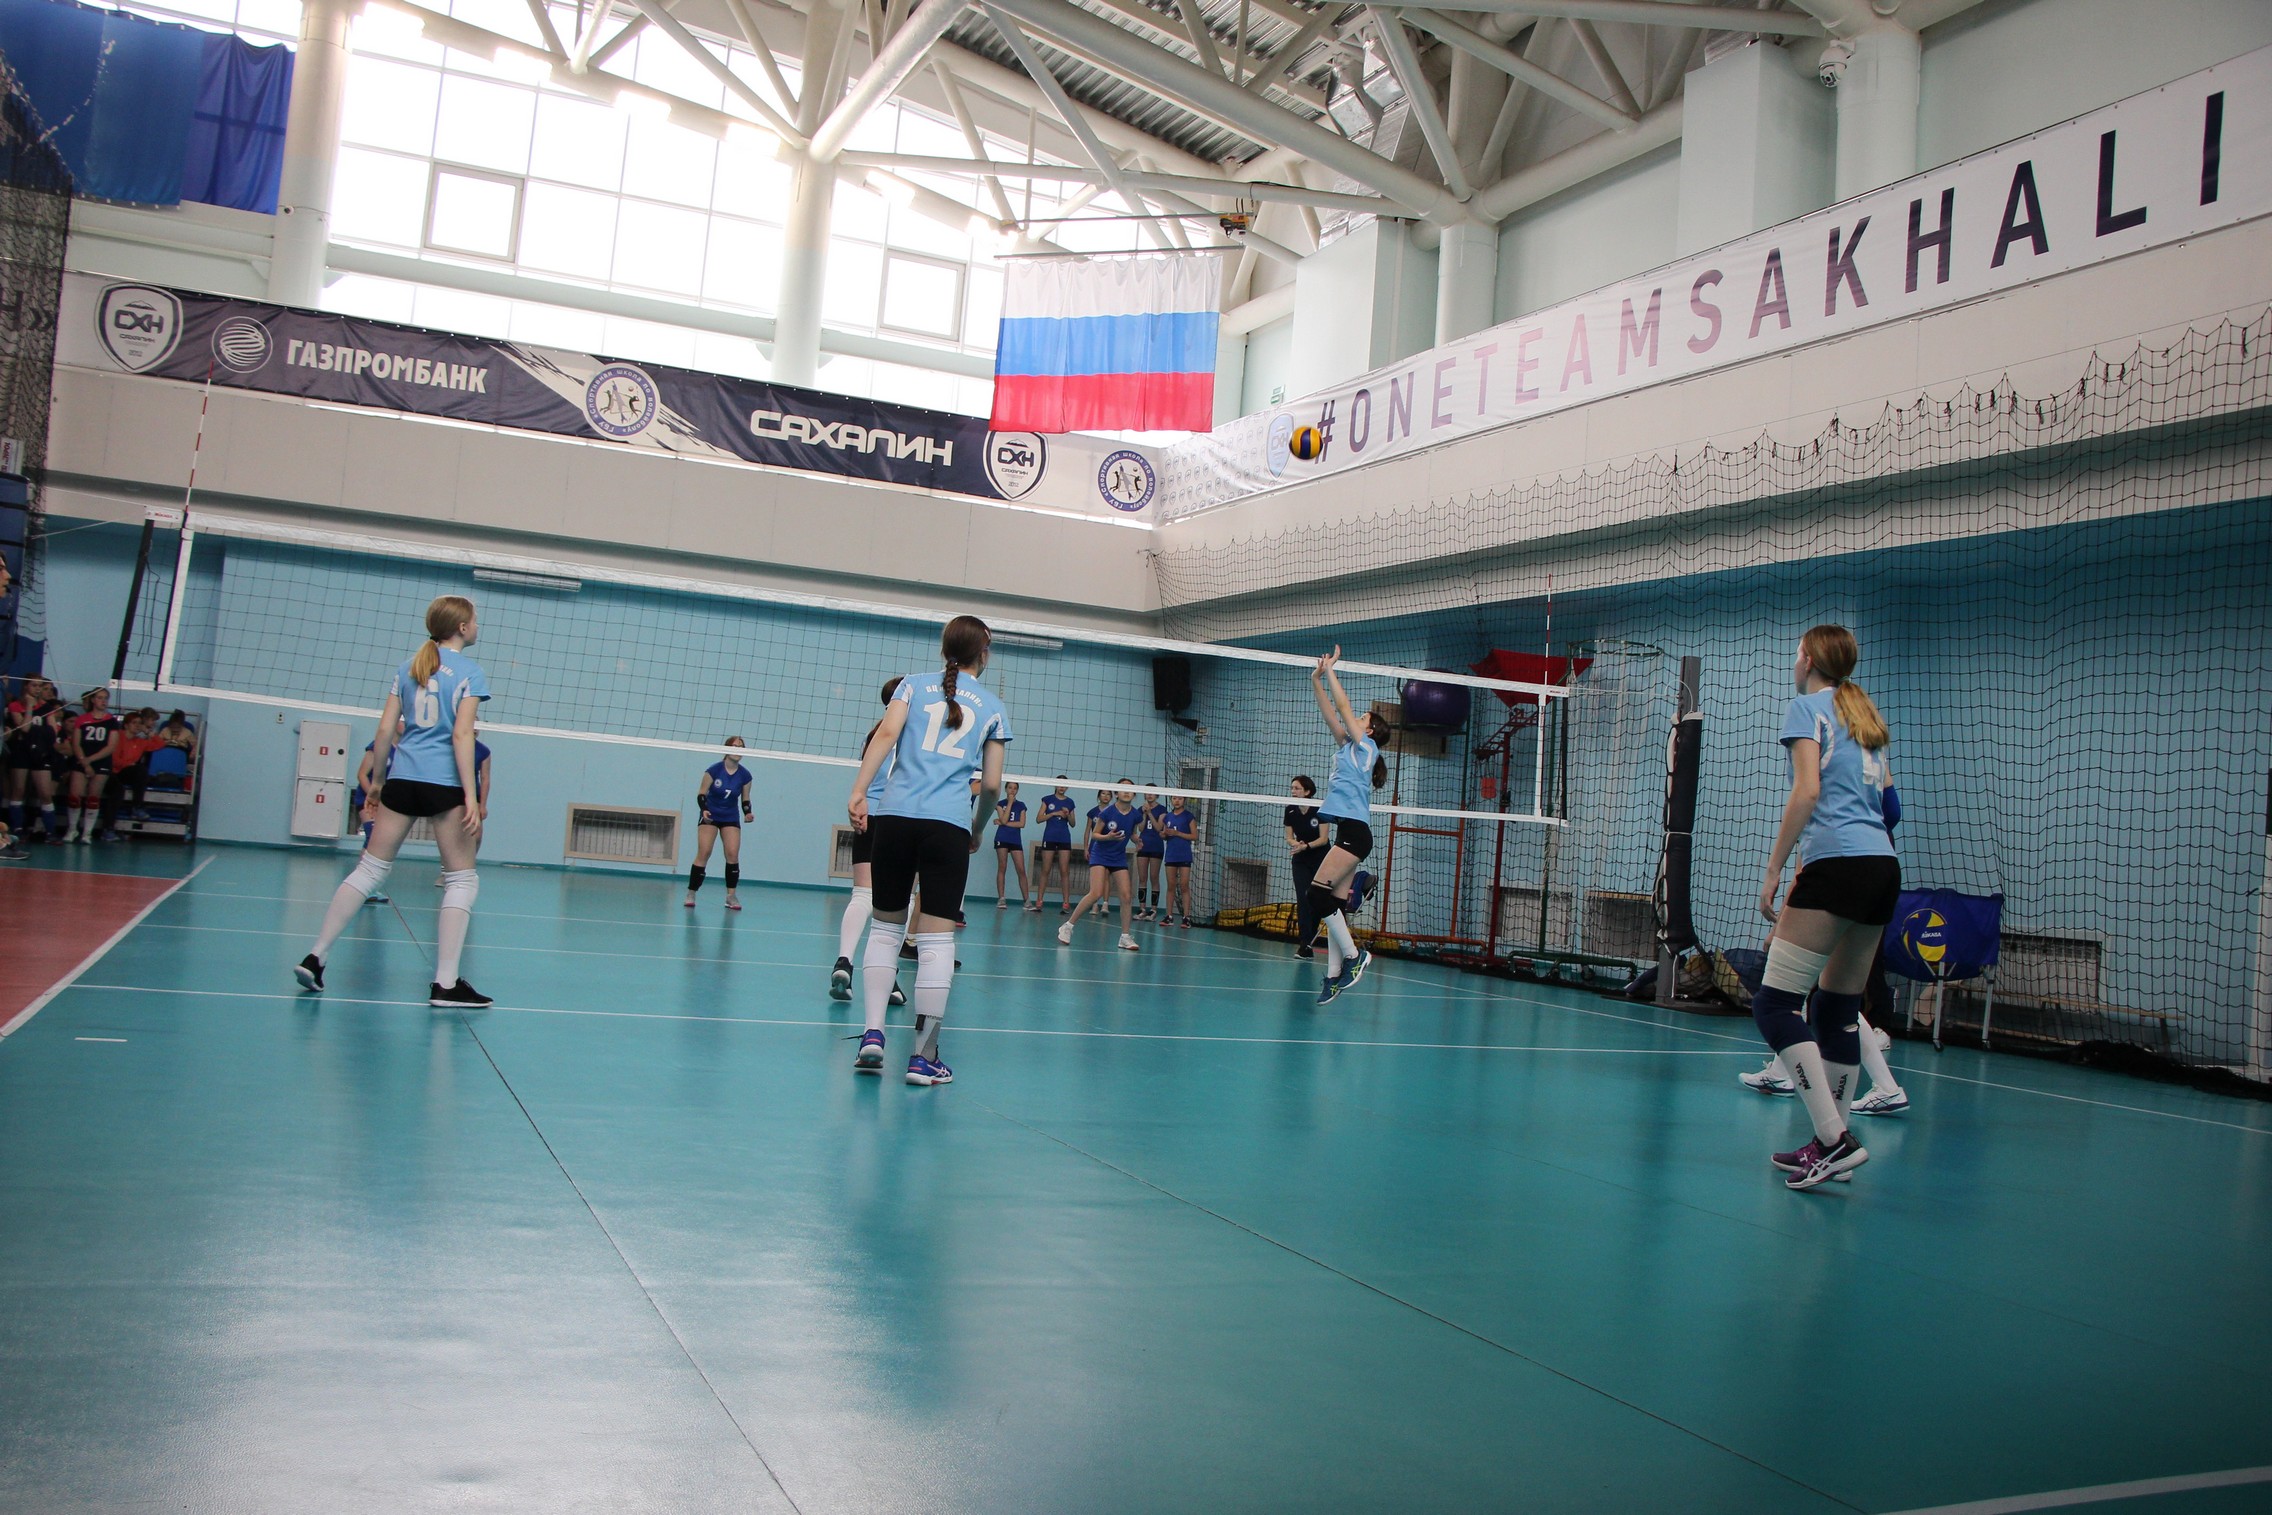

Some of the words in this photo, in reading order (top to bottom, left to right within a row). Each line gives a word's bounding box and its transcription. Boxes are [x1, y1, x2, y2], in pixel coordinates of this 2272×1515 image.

[286, 339, 488, 394] ГАЗПРОМБАНК
[750, 409, 954, 467] САХАЛИН
[415, 679, 439, 728] 6
[85, 726, 106, 741] 20
[921, 700, 976, 759] 12
[724, 789, 732, 799] 7
[1795, 1061, 1811, 1090] MIKASA
[1833, 1073, 1848, 1101] MIKASA
